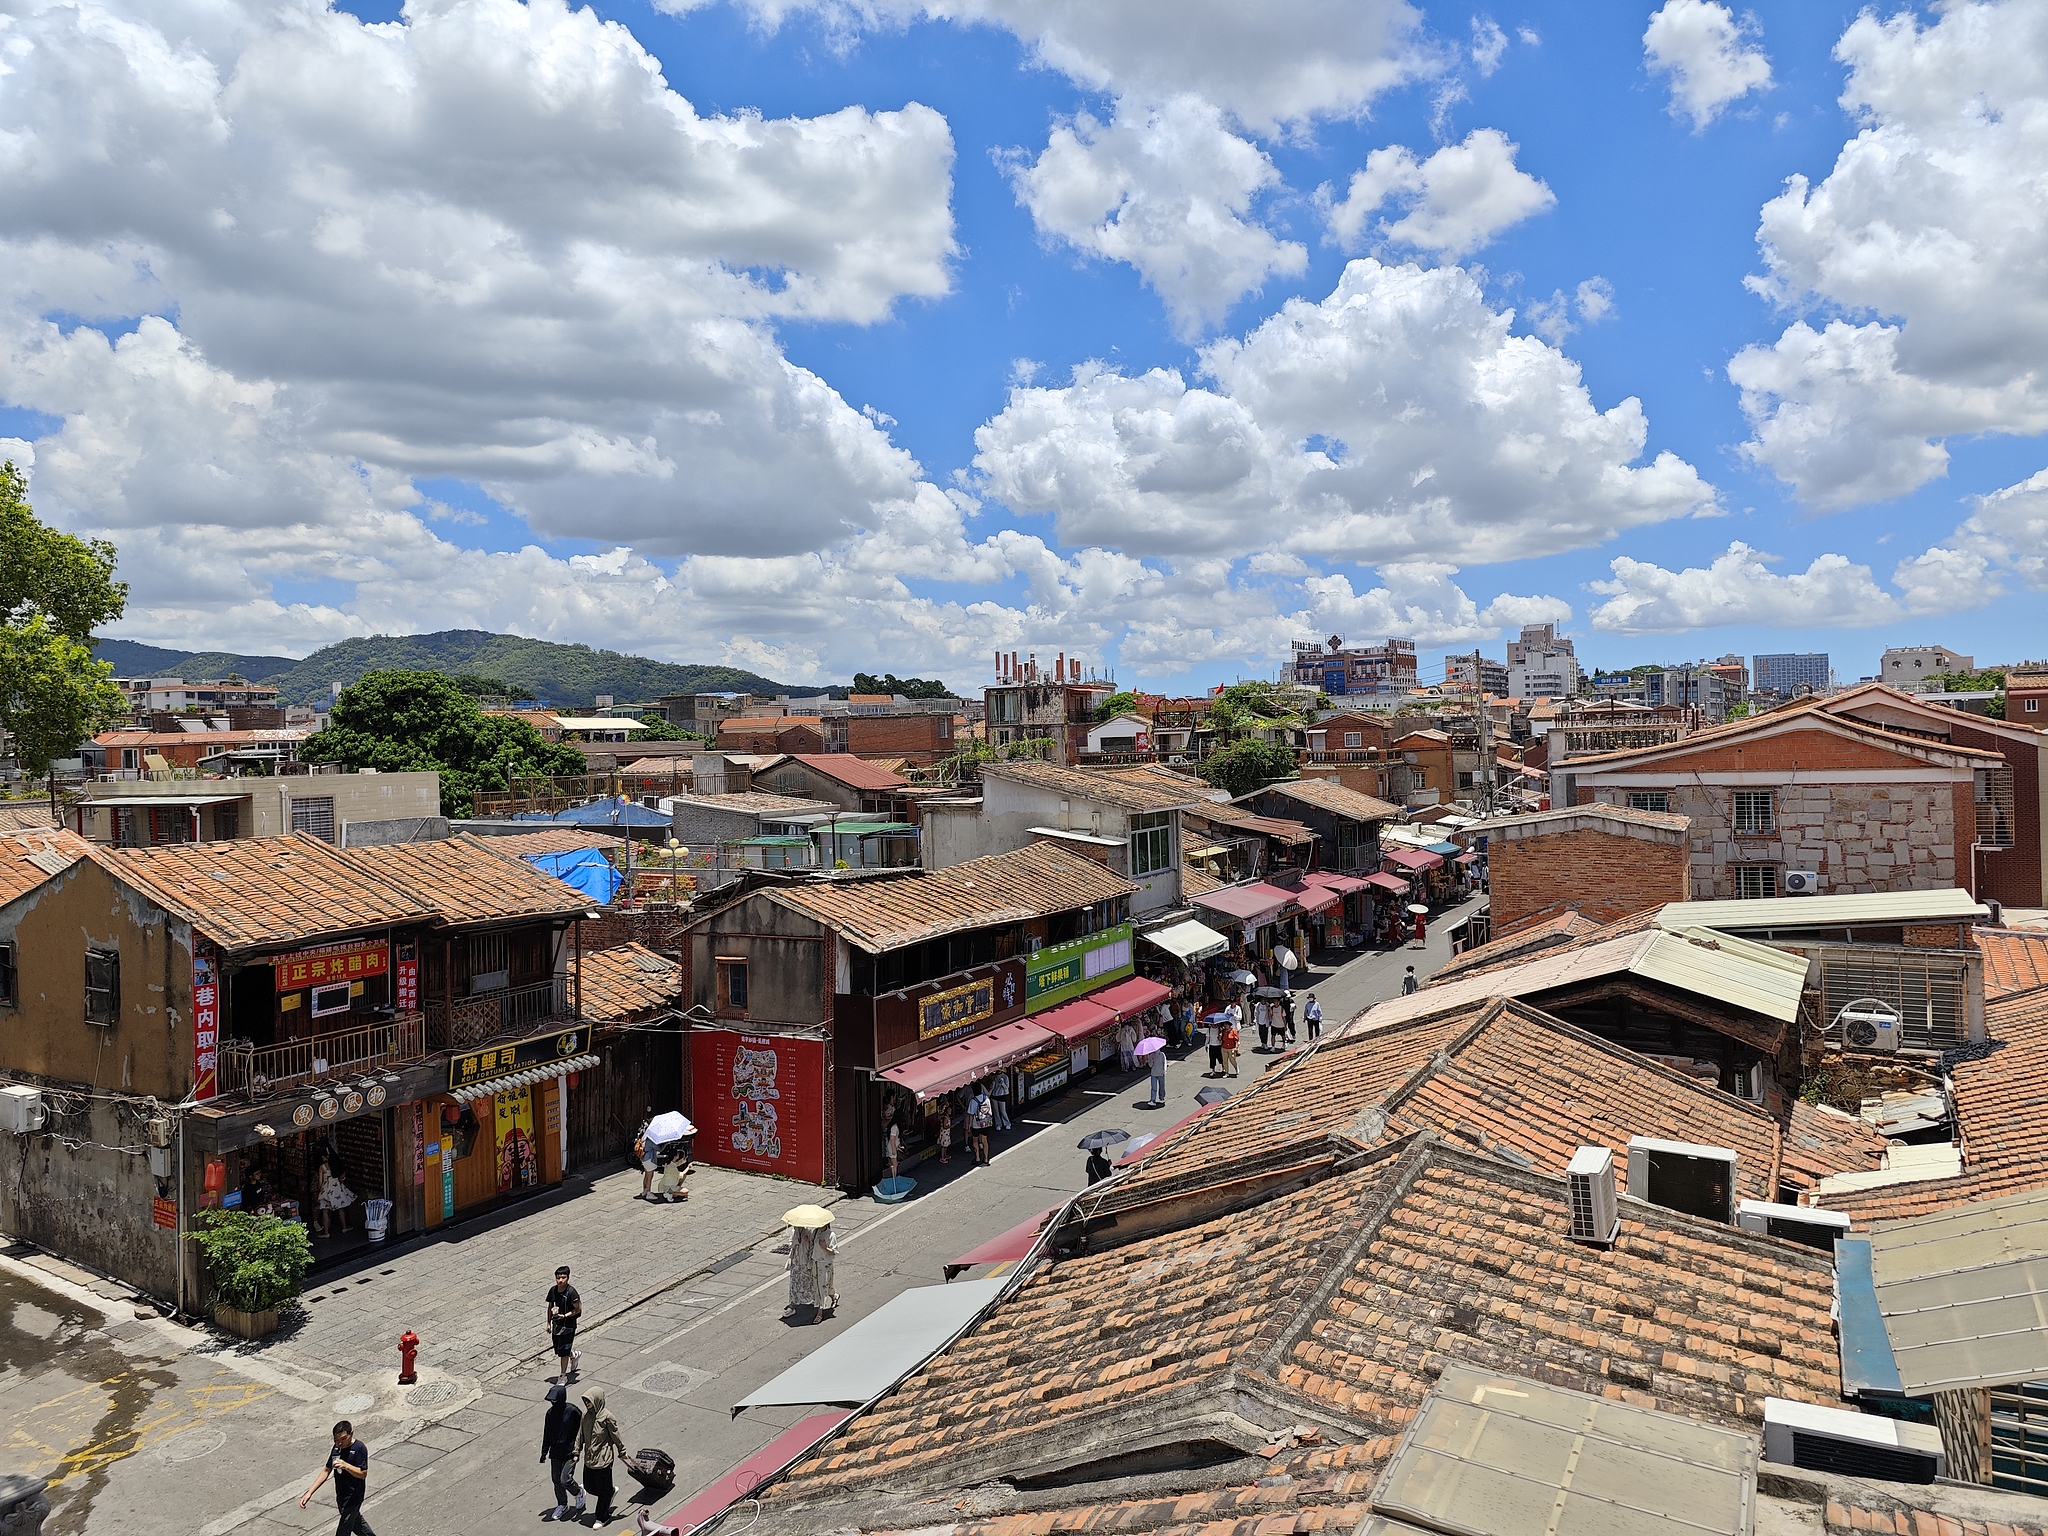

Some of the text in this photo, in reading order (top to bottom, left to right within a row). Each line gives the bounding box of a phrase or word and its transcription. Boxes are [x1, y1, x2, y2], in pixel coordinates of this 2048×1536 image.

[292, 953, 379, 980] 正宗炸醋肉
[195, 987, 215, 1072] 巷内取餐
[461, 1047, 516, 1076] 锦鲤司
[461, 1059, 537, 1083] KOI FORTUNE STATION
